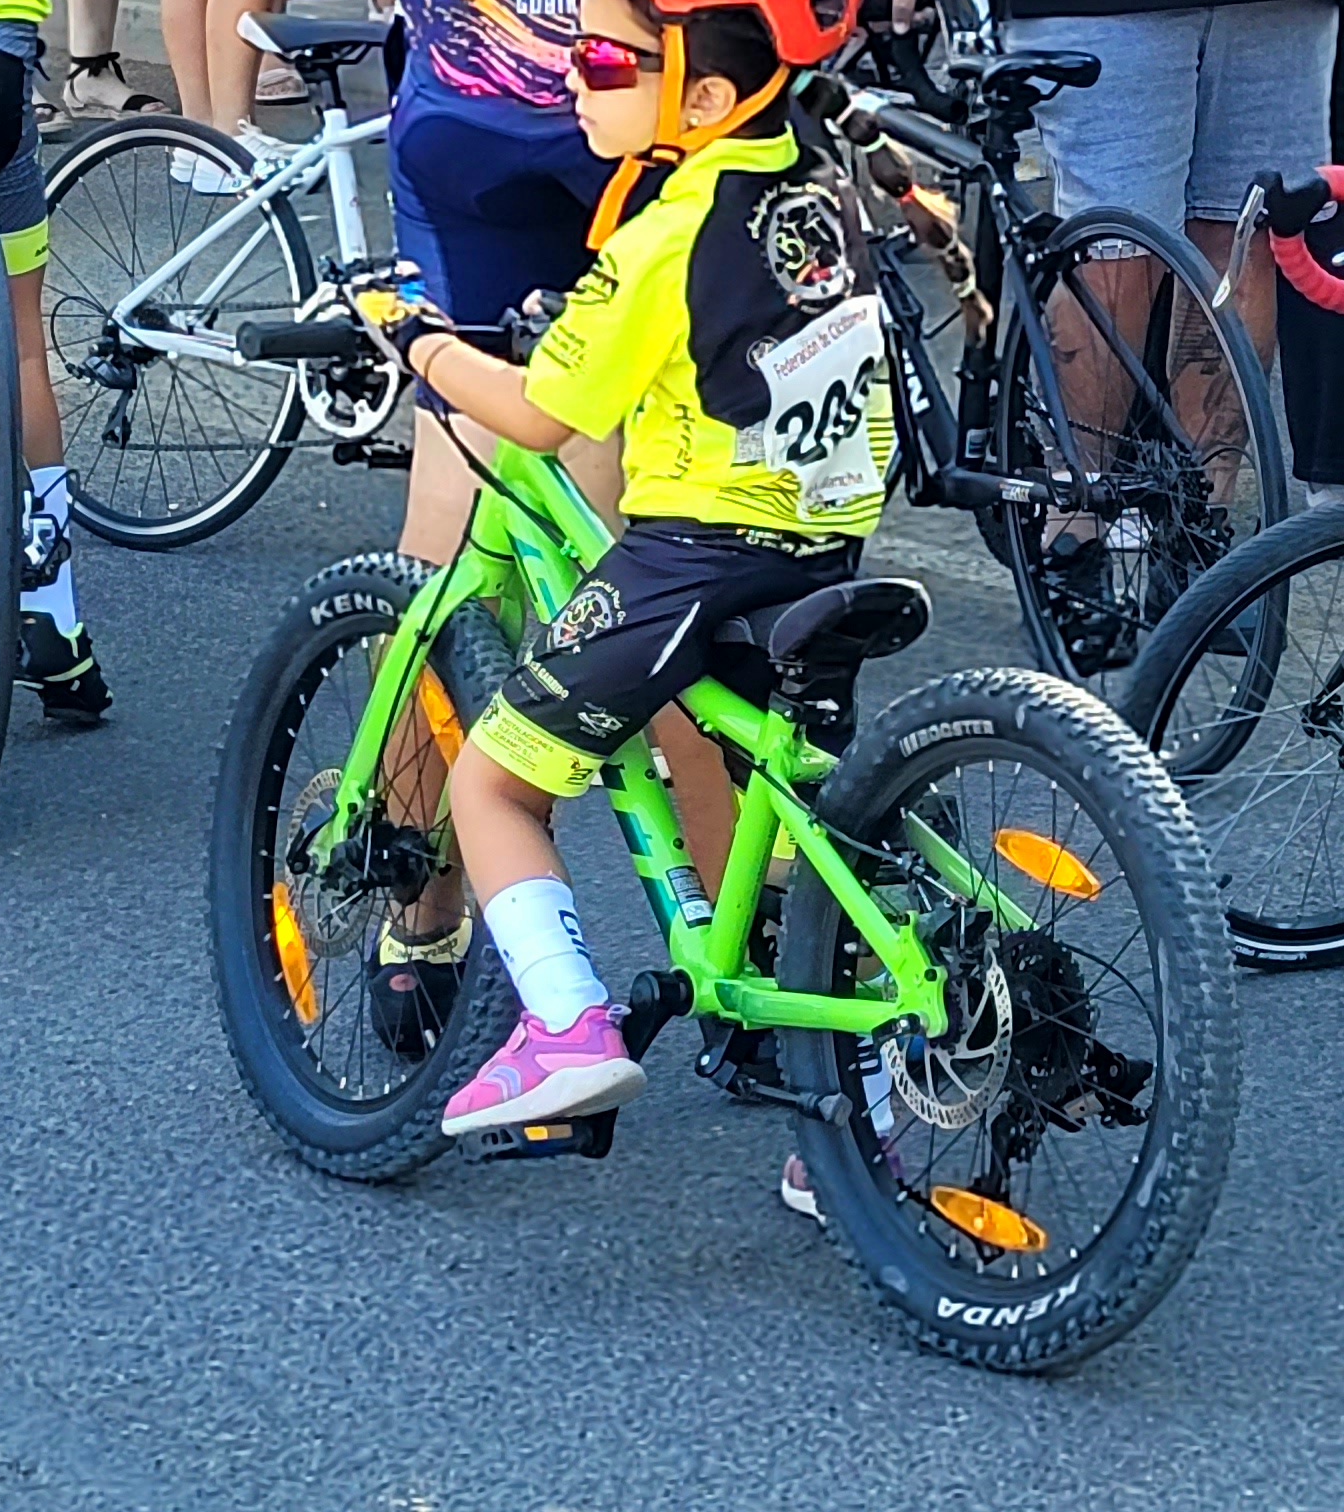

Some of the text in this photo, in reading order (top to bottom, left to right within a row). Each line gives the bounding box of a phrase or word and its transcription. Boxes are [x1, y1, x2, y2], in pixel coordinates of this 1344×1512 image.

[772, 336, 820, 381] Federación
[818, 332, 833, 349] de
[938, 1273, 1081, 1327] KENDA
